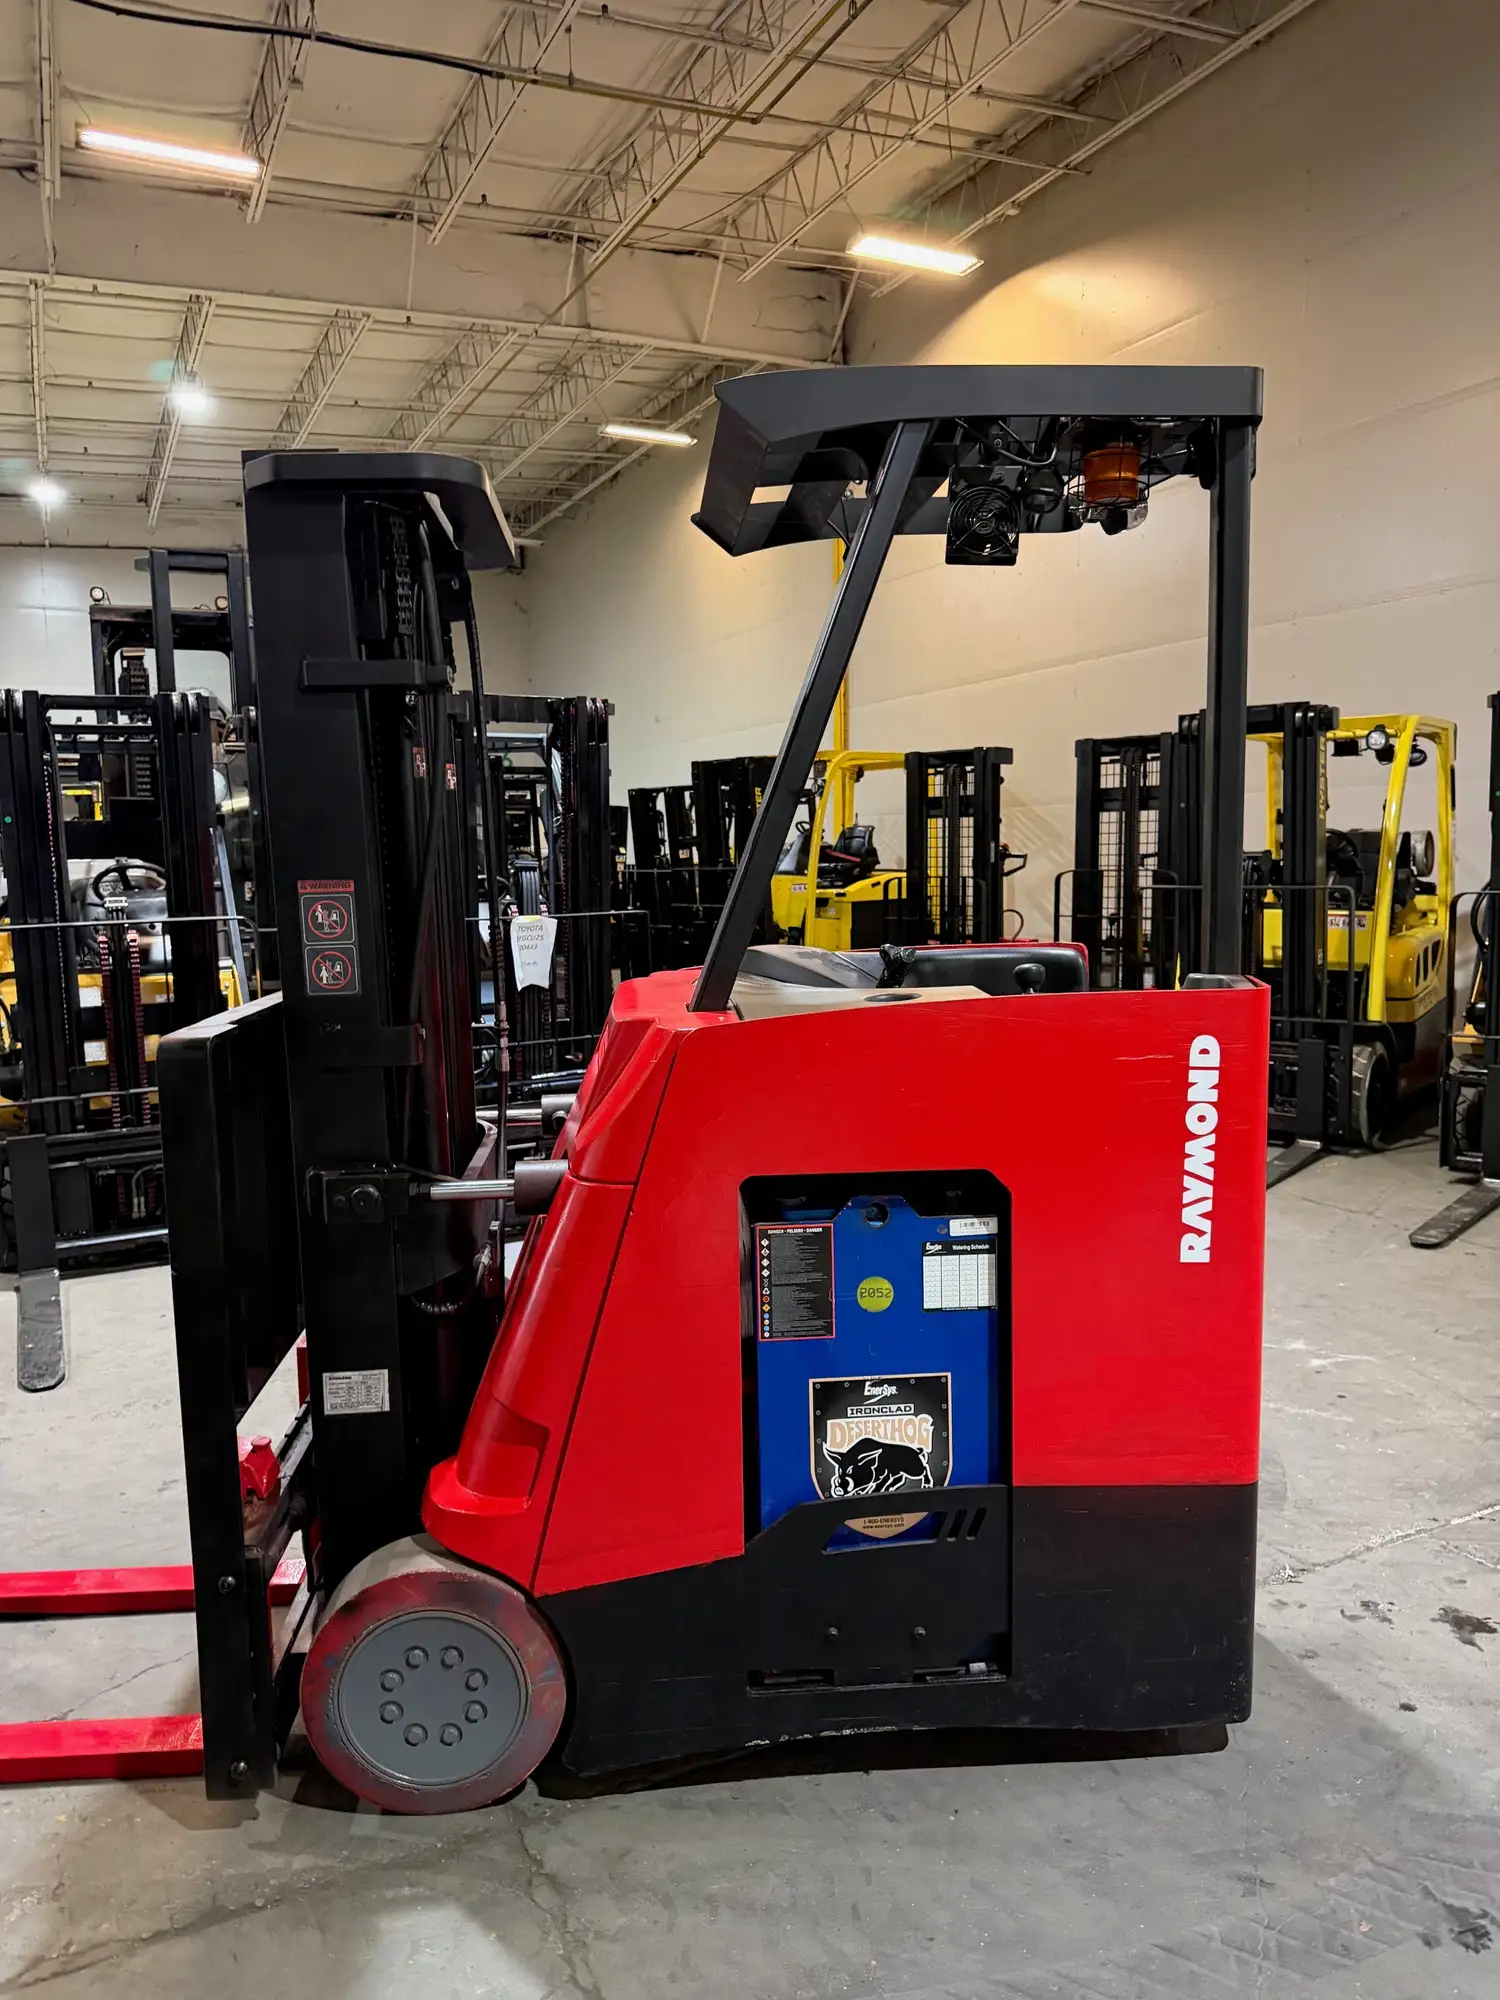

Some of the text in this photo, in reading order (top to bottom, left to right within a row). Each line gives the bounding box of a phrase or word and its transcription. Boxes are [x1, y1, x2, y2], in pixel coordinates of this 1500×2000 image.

[308, 881, 351, 890] WARNING
[518, 924, 544, 932] TOYOTA
[1180, 1034, 1221, 1263] RAYMOND
[860, 1287, 893, 1299] 2052
[849, 1405, 912, 1416] IRONCLAD
[827, 1414, 934, 1453] DESERTHOG
